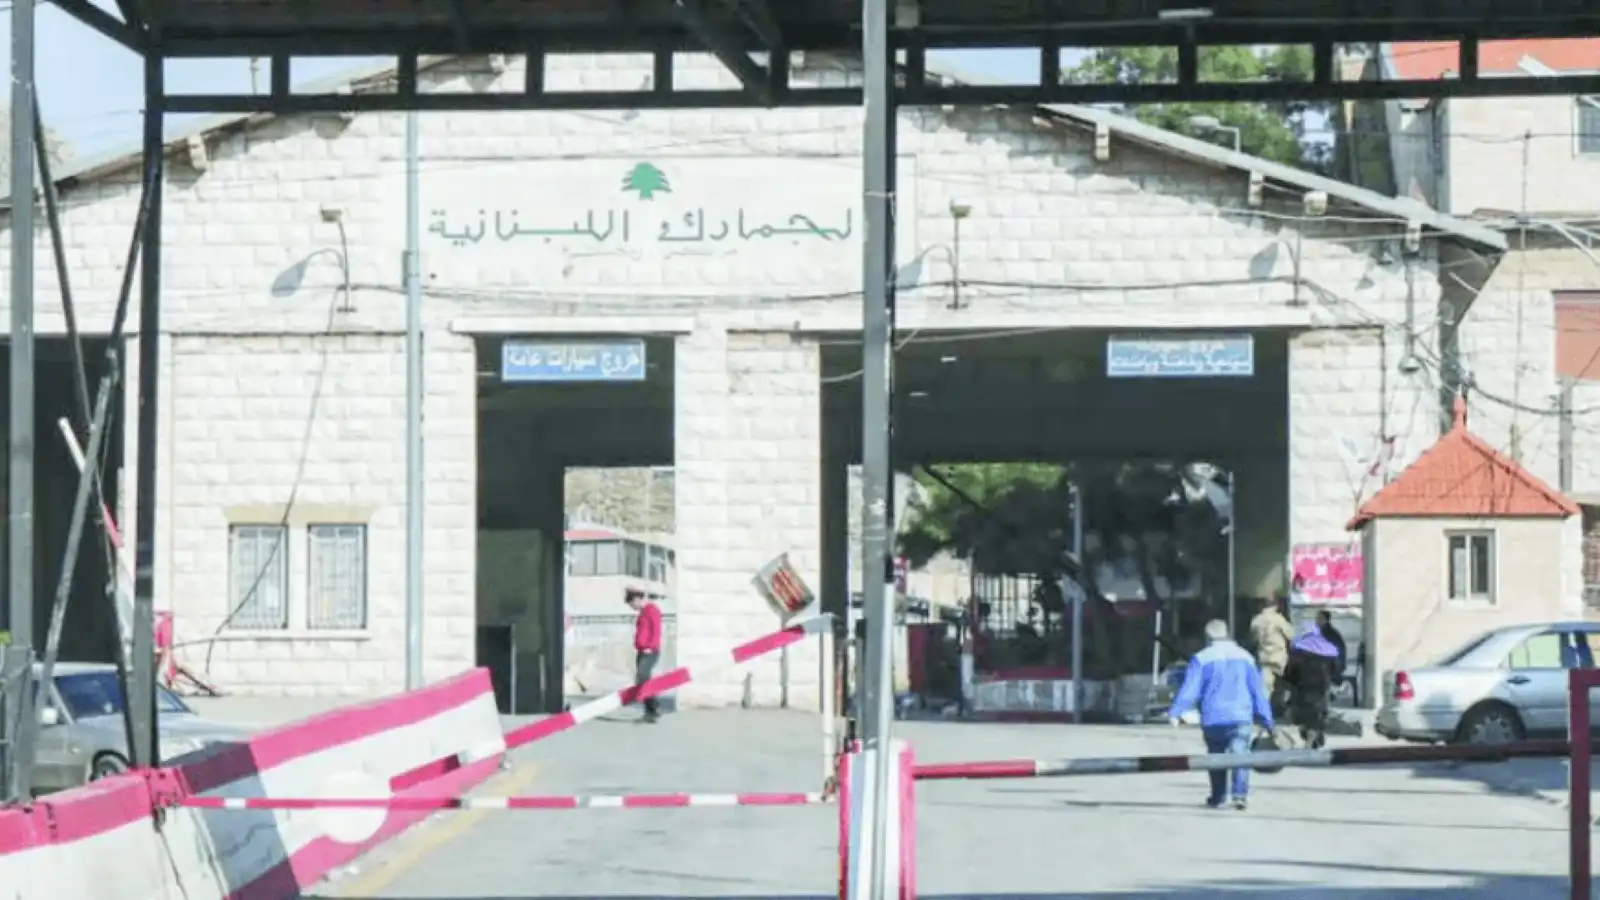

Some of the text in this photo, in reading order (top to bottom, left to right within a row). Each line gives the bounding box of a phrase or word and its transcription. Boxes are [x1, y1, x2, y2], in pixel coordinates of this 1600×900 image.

[428, 207, 852, 247] لجمارك اللبنانية
[547, 343, 597, 374] سيارات
